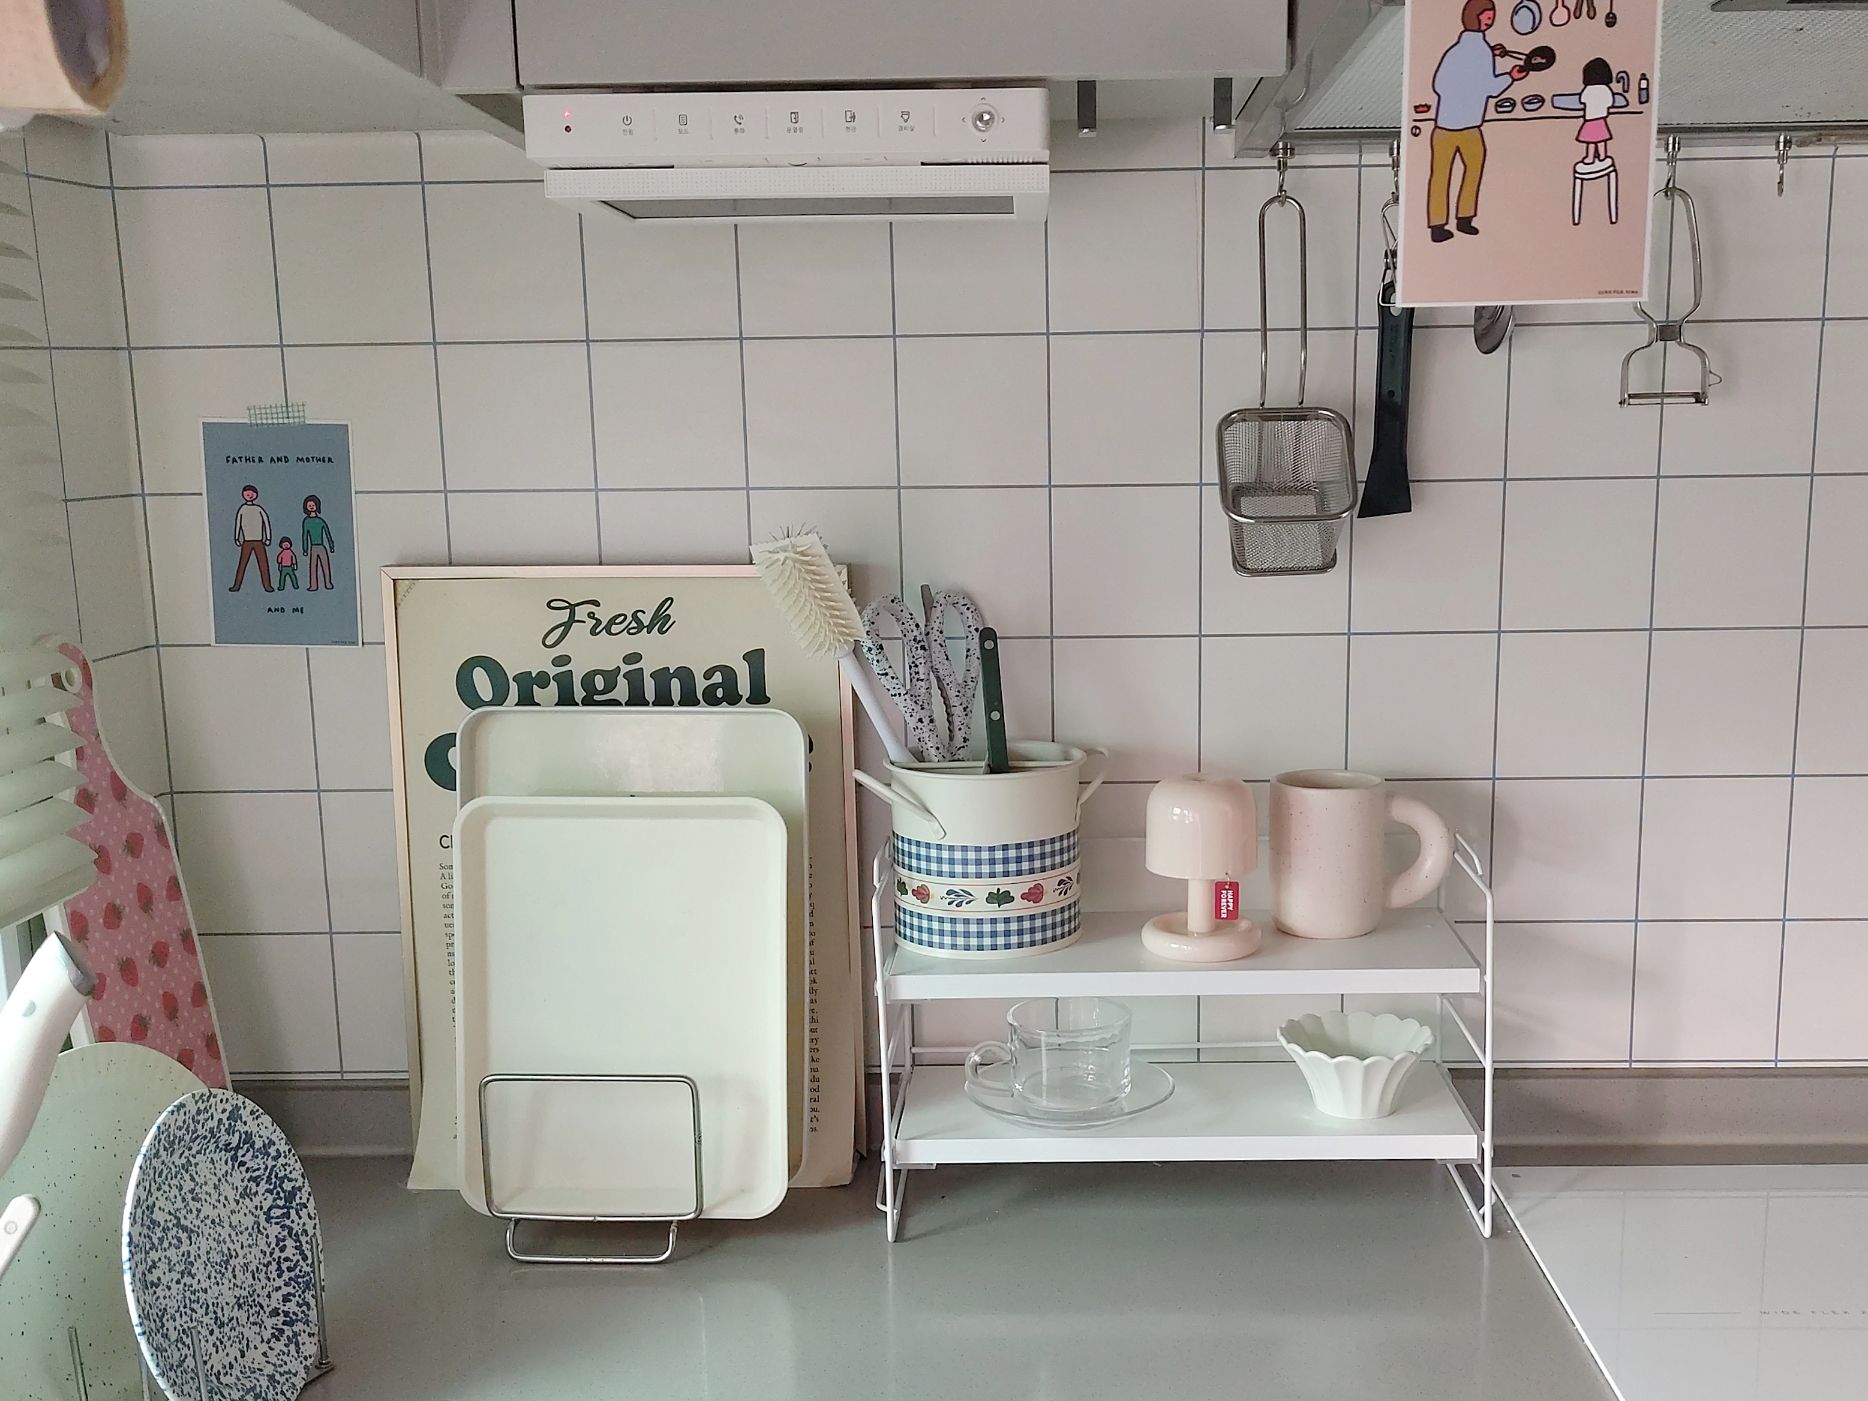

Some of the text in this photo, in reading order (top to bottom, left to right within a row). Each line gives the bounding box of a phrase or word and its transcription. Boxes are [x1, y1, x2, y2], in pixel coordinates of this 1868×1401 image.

[225, 455, 335, 464] FATHER AND MOTHER
[267, 606, 305, 614] AND ME
[541, 596, 677, 650] Fresh
[455, 648, 772, 710] Original
